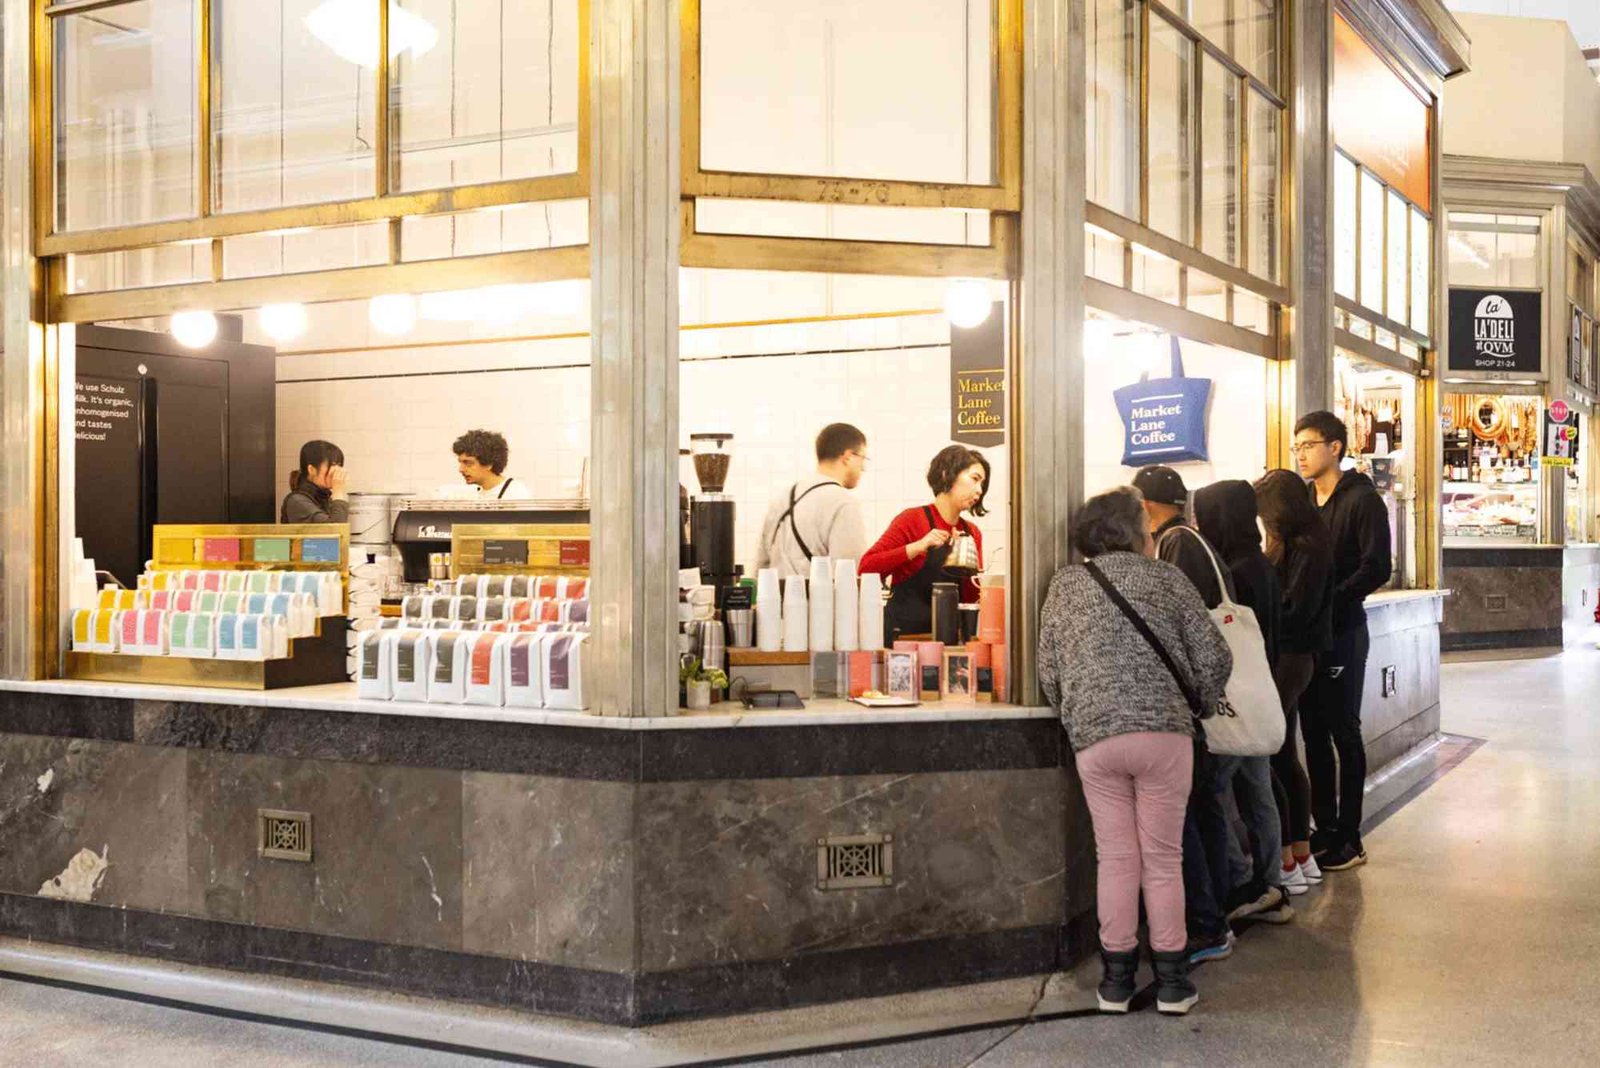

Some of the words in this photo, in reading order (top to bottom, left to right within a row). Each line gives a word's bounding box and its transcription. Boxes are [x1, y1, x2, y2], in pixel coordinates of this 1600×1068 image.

[1474, 319, 1514, 339] LA'DELI
[1482, 341, 1514, 355] QVM
[1475, 359, 1495, 367] SHOP
[100, 384, 125, 394] Schulz
[958, 378, 1006, 393] Market
[104, 398, 134, 408] organic,
[958, 395, 992, 409] Lane
[75, 407, 129, 418] nhomogenised
[957, 410, 1001, 425] Coffee
[1131, 404, 1183, 419] Market
[87, 420, 112, 429] tastes
[1131, 420, 1166, 432] Lane
[75, 431, 106, 441] elicious!
[1131, 431, 1176, 446] Coffee
